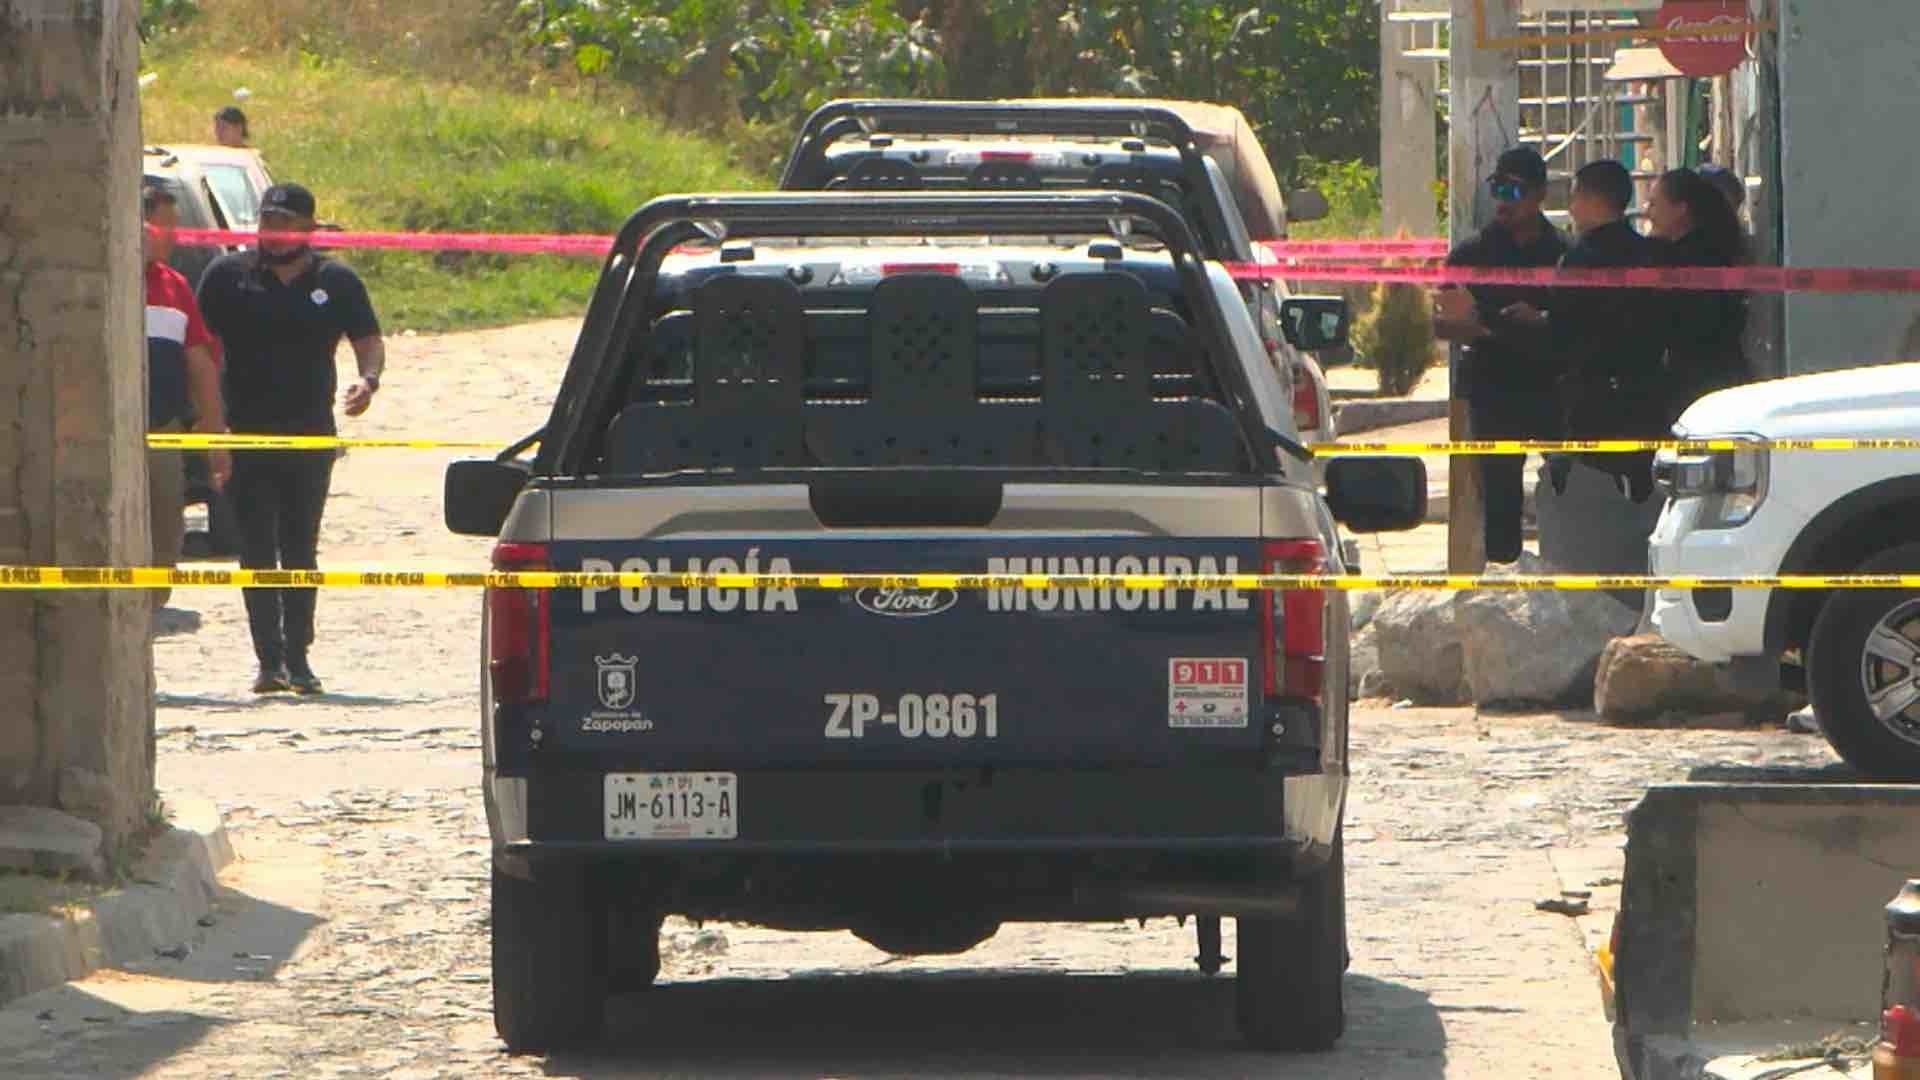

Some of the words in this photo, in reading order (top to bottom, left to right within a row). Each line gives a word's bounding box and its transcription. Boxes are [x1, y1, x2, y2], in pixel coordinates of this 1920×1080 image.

[581, 548, 799, 612] POLICÍA
[987, 556, 1249, 611] MUNICIPAL
[872, 586, 937, 611] Ford
[582, 718, 653, 732] Zapopan
[824, 693, 997, 737] ZP-0861
[610, 792, 730, 819] JM-6113-A
